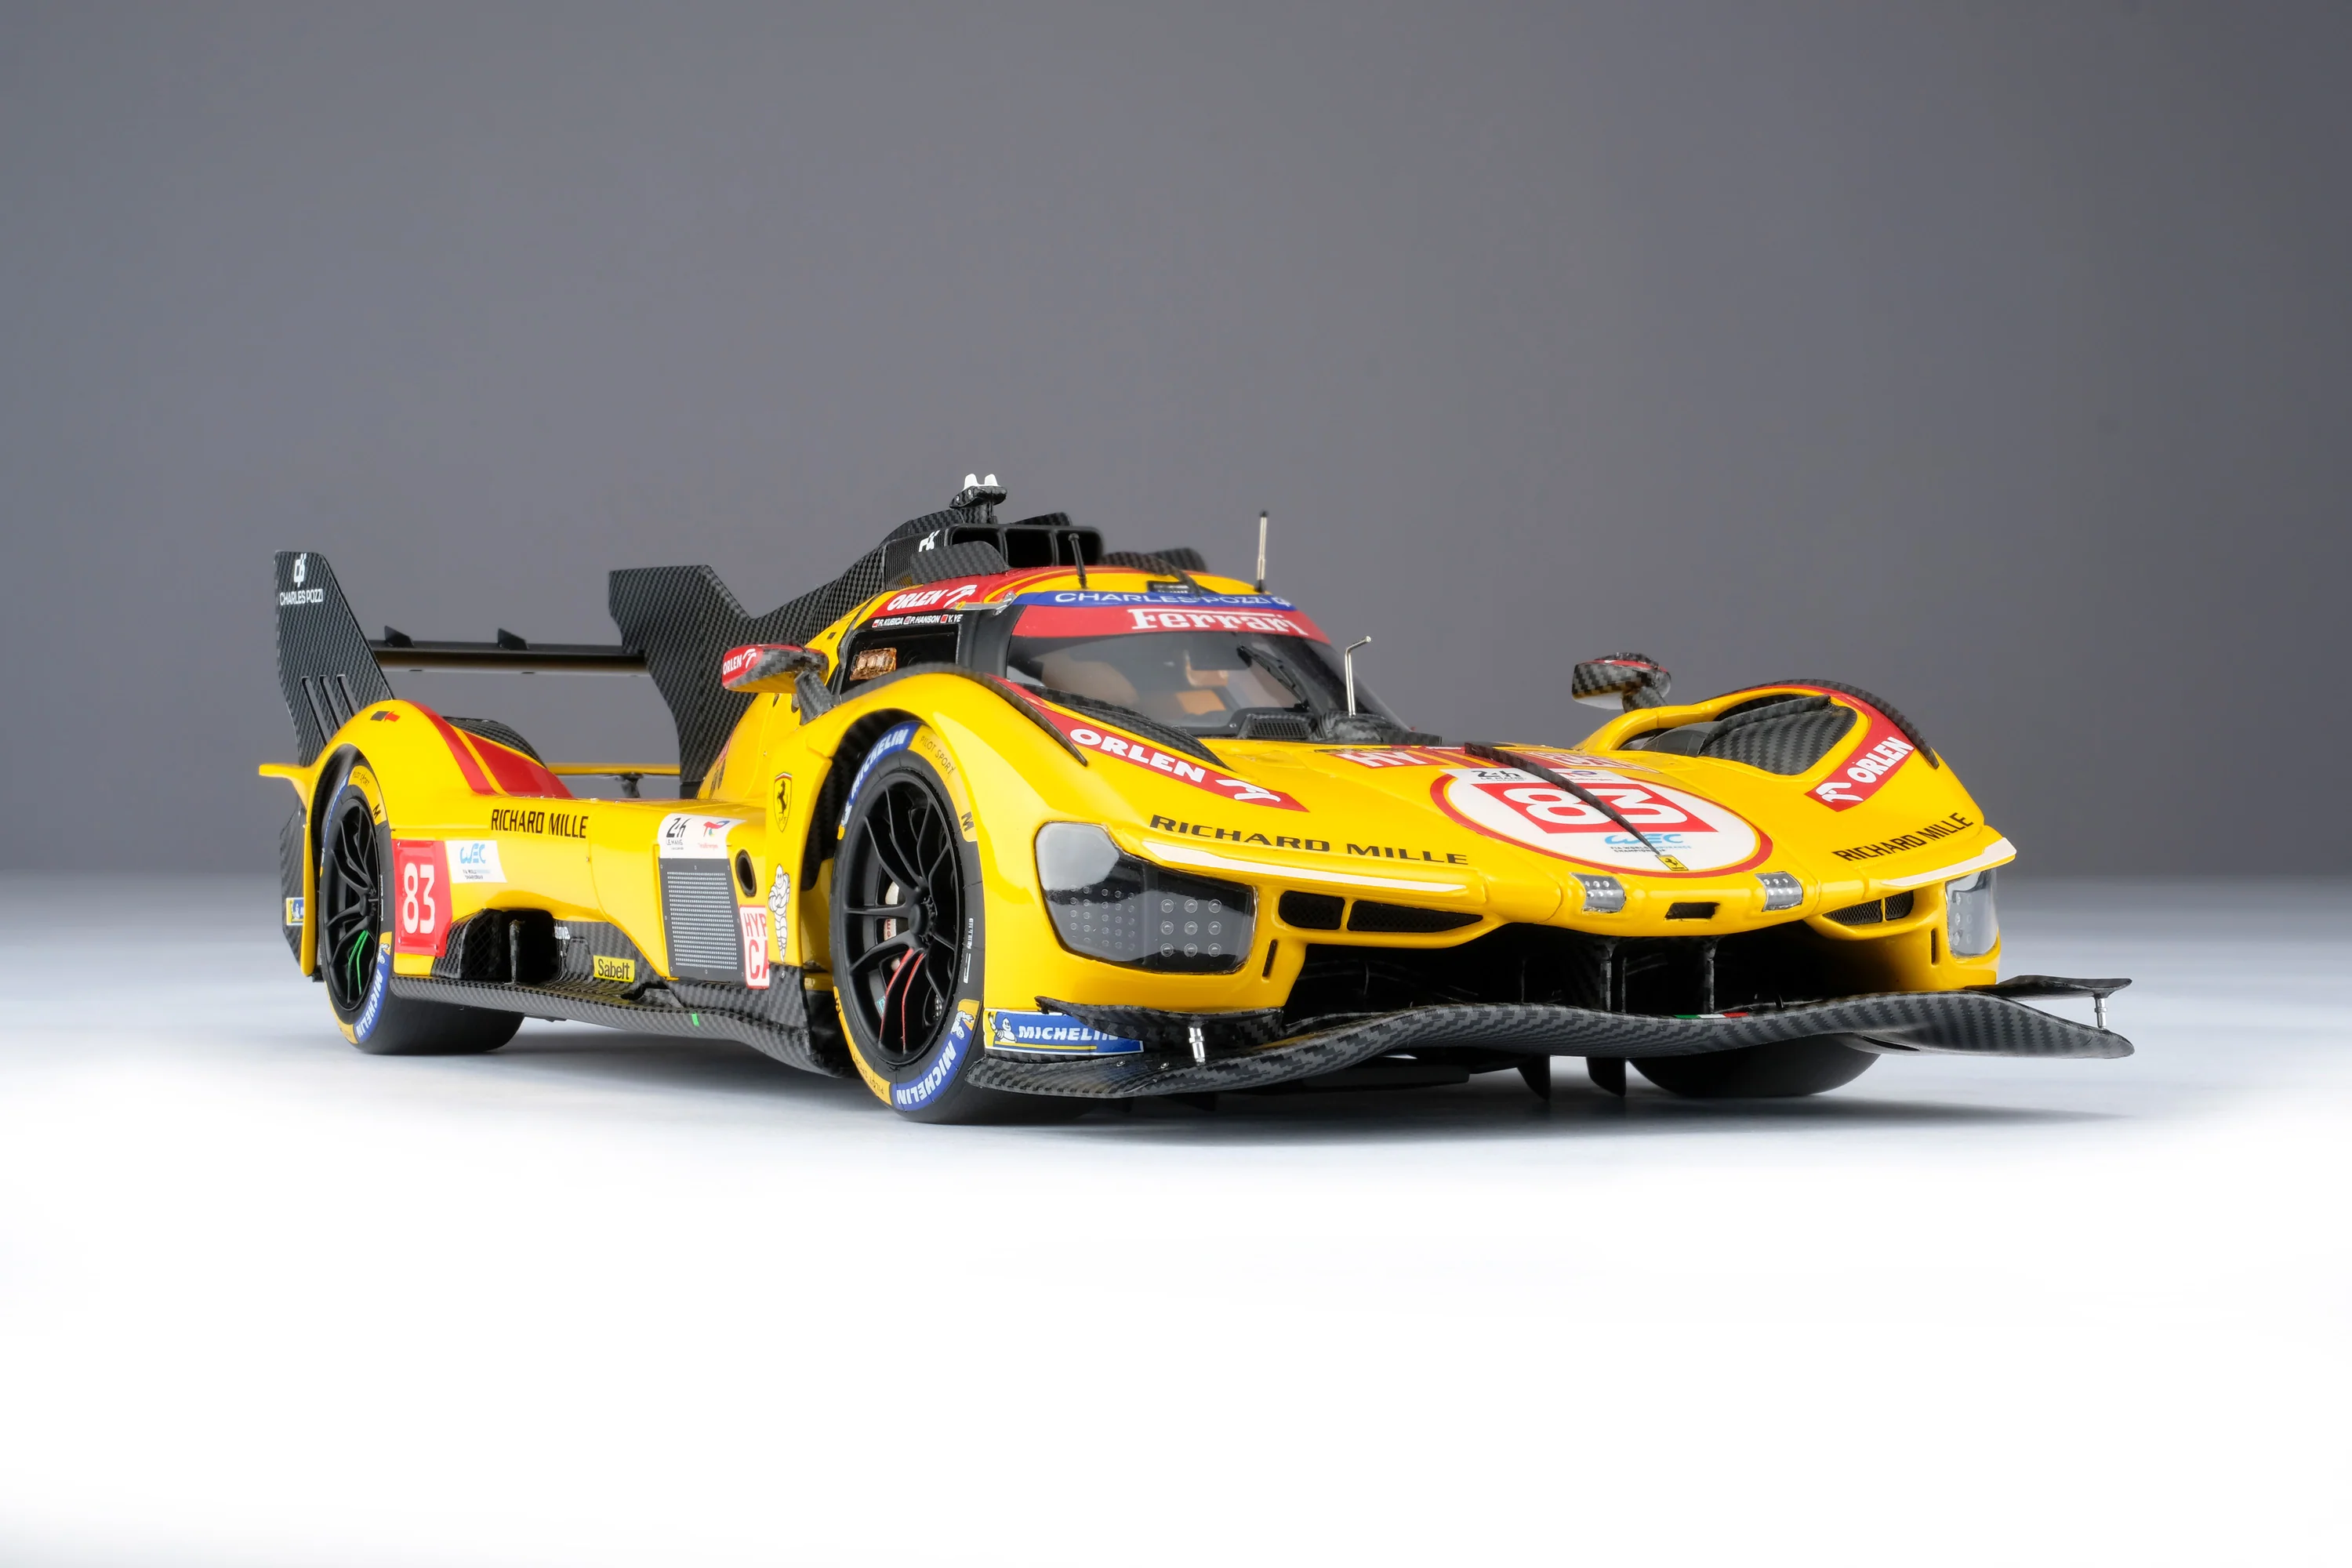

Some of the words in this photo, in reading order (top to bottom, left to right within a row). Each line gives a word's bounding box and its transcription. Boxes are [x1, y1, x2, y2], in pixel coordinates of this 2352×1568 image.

[279, 590, 306, 606] CHARLES
[306, 588, 323, 604] POZZI
[887, 589, 949, 612] ORLEN
[1054, 593, 1199, 603] CHARLES
[1200, 596, 1272, 604] POZZI
[1127, 608, 1308, 637] Ferrari
[723, 654, 742, 675] ORLEN
[851, 728, 909, 800] MICHELIN
[920, 735, 936, 752] PILOT
[935, 750, 954, 775] SPORT
[1069, 728, 1206, 782] ORLEN
[1847, 736, 1915, 783] ORLEN
[491, 809, 545, 834] RICHARD
[549, 813, 589, 839] MILLE
[1503, 788, 1688, 825] 83
[460, 843, 486, 864] WEC
[1149, 814, 1330, 852] RICHARD
[1346, 843, 1468, 866] MILLE
[1605, 833, 1683, 844] WEC
[1831, 834, 1927, 861] RICHARD
[1915, 812, 1974, 841] MILLE
[402, 862, 435, 934] 83
[597, 958, 630, 980] Sabelt
[356, 968, 383, 1038] MICHELIN
[896, 1040, 956, 1105] MICHELIN
